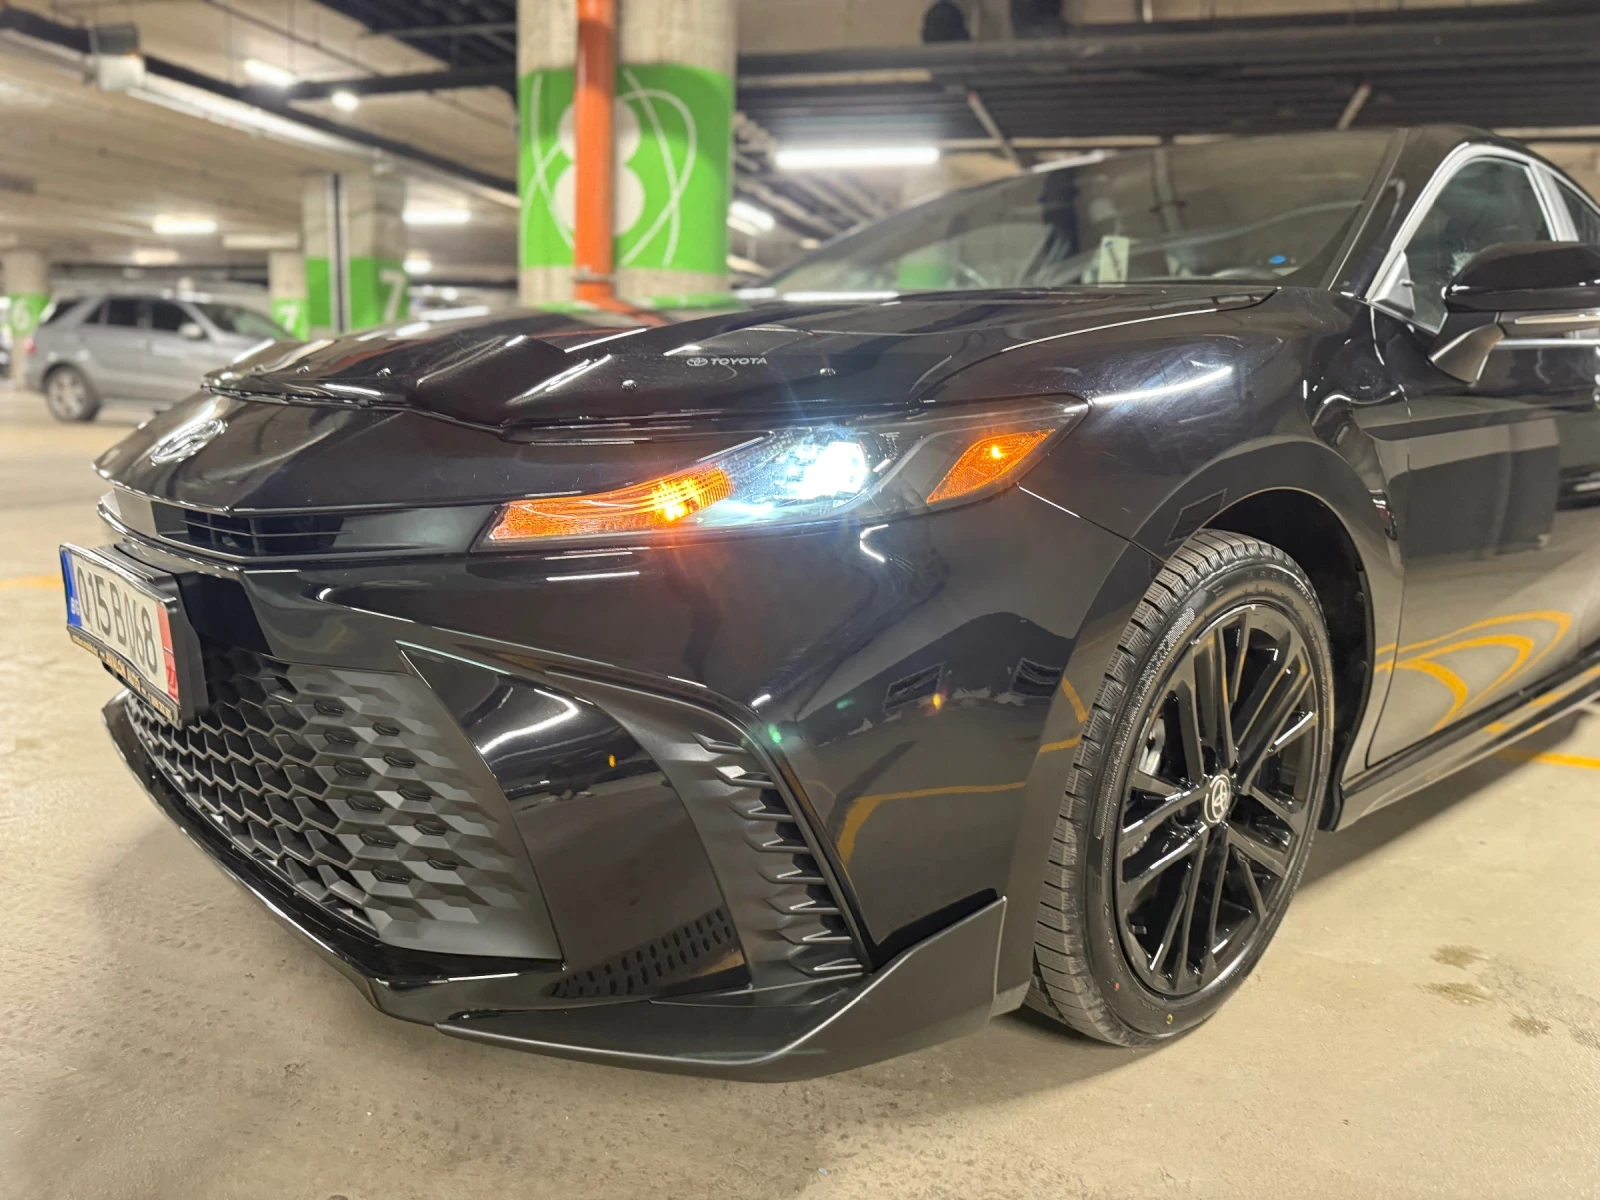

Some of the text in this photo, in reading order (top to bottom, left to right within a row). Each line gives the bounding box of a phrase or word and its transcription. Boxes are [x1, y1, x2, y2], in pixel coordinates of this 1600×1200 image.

[379, 269, 408, 323] 7
[278, 303, 300, 331] 7
[710, 357, 768, 366] TOYOTA
